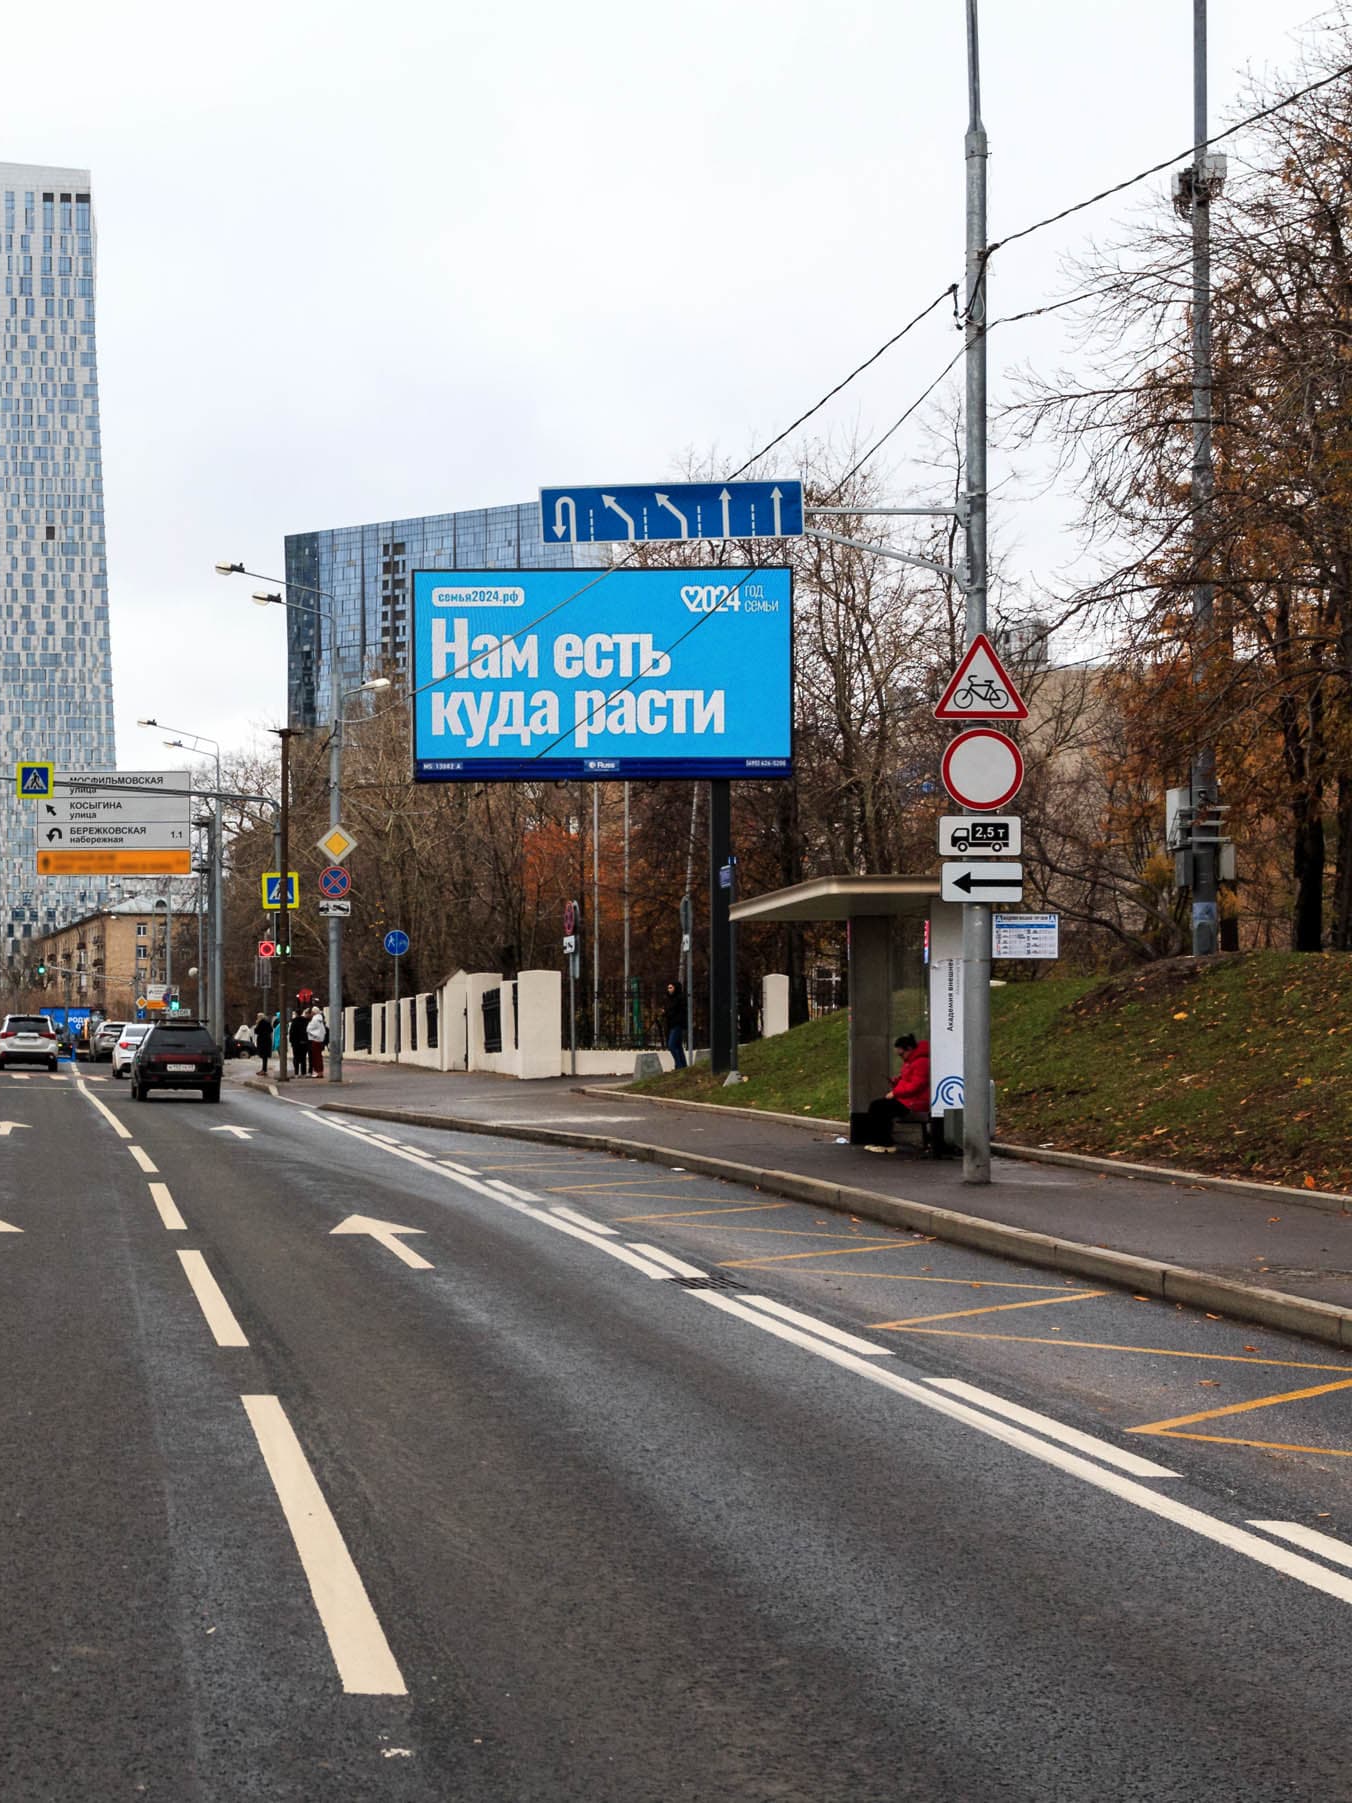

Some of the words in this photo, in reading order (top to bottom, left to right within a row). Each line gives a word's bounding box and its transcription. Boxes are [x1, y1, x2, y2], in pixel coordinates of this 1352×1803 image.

[438, 590, 519, 604] семья2024.рф
[691, 585, 741, 612] 2024
[744, 584, 764, 599] год
[744, 599, 779, 613] семьи
[431, 618, 539, 679] Нам
[553, 632, 671, 678] есть
[431, 690, 560, 747] куда
[574, 690, 725, 748] расти
[69, 786, 97, 795] улица
[69, 801, 123, 809] КОСЫГИНА
[69, 812, 97, 820] улица
[69, 826, 147, 835] БЕРЕЖКОВСКАЯ
[170, 831, 183, 839] 1.1
[975, 826, 995, 840] 2,5
[69, 836, 124, 844] набережная
